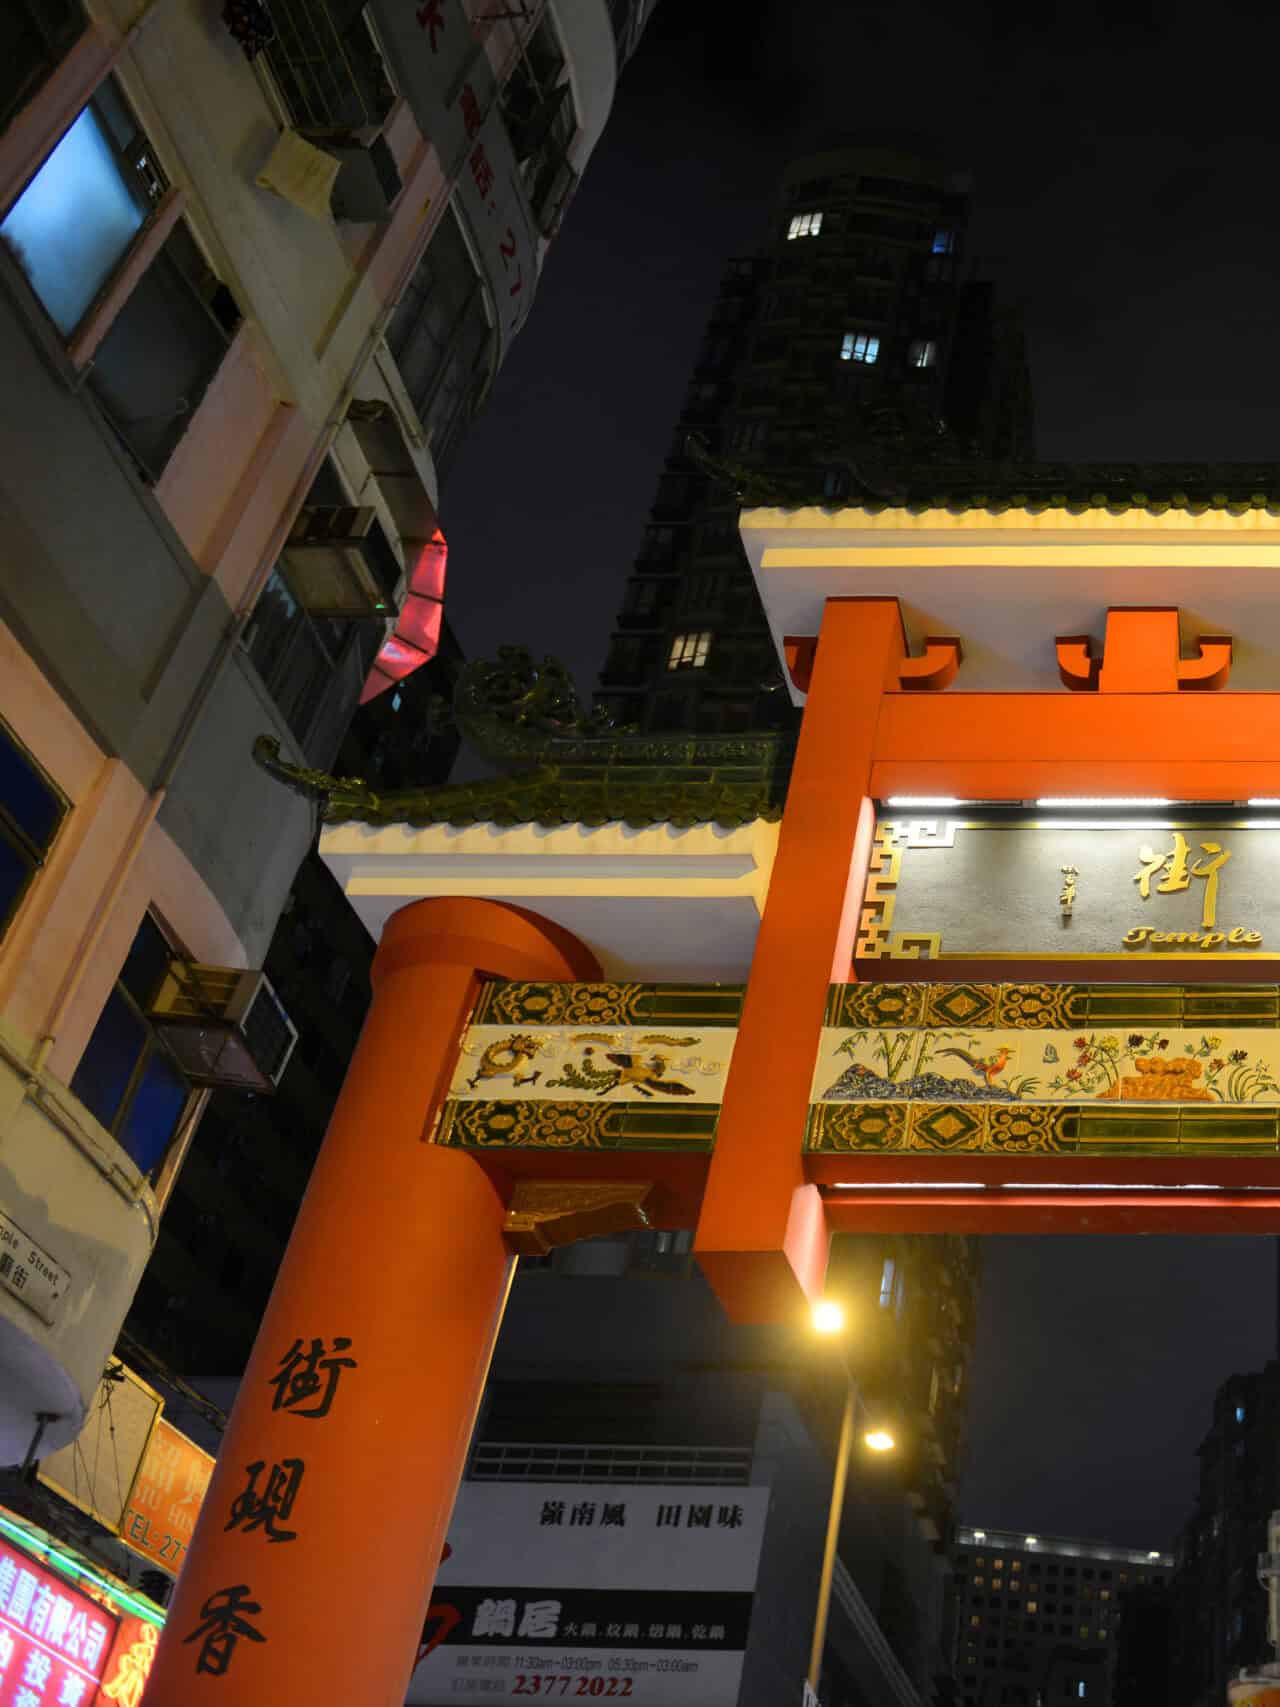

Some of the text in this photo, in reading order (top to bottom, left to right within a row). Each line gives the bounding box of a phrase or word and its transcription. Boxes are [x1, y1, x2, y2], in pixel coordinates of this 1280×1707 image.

[1122, 926, 1264, 948] Temple
[27, 1251, 59, 1286] Street
[656, 1503, 744, 1529] 田園味
[160, 1535, 188, 1561] 27
[512, 1674, 571, 1696] 2377
[575, 1676, 634, 1697] 2022
